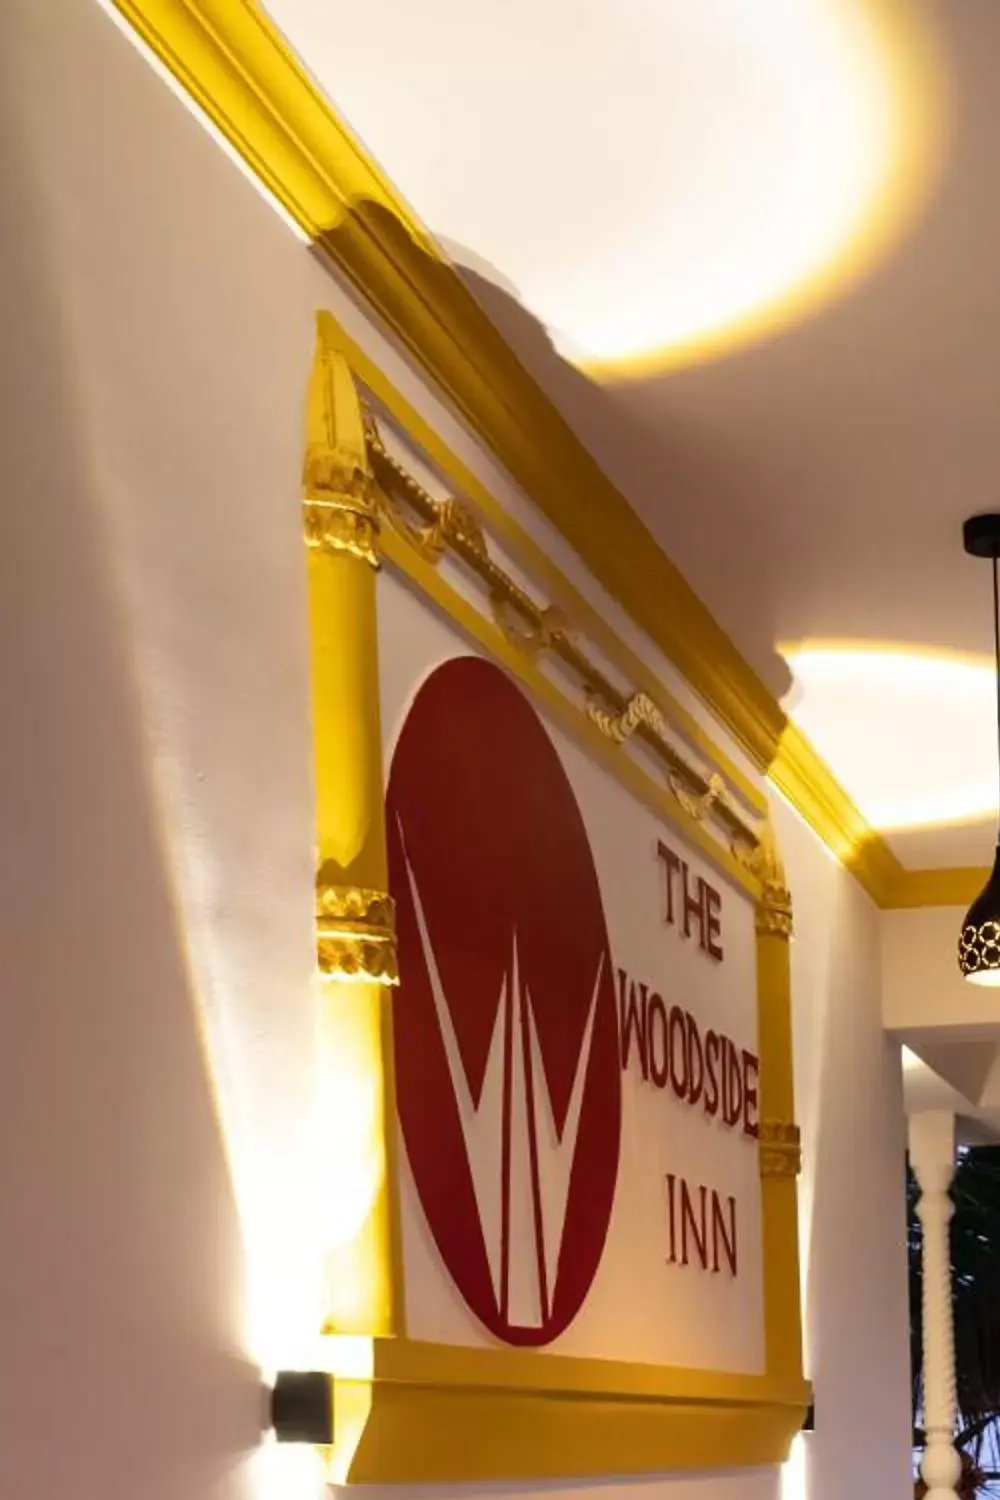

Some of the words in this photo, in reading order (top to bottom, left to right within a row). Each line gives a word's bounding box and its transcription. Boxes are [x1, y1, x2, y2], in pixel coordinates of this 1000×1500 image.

[656, 837, 724, 962] THE
[617, 967, 760, 1139] WOODSIDE
[666, 1174, 738, 1277] INN
